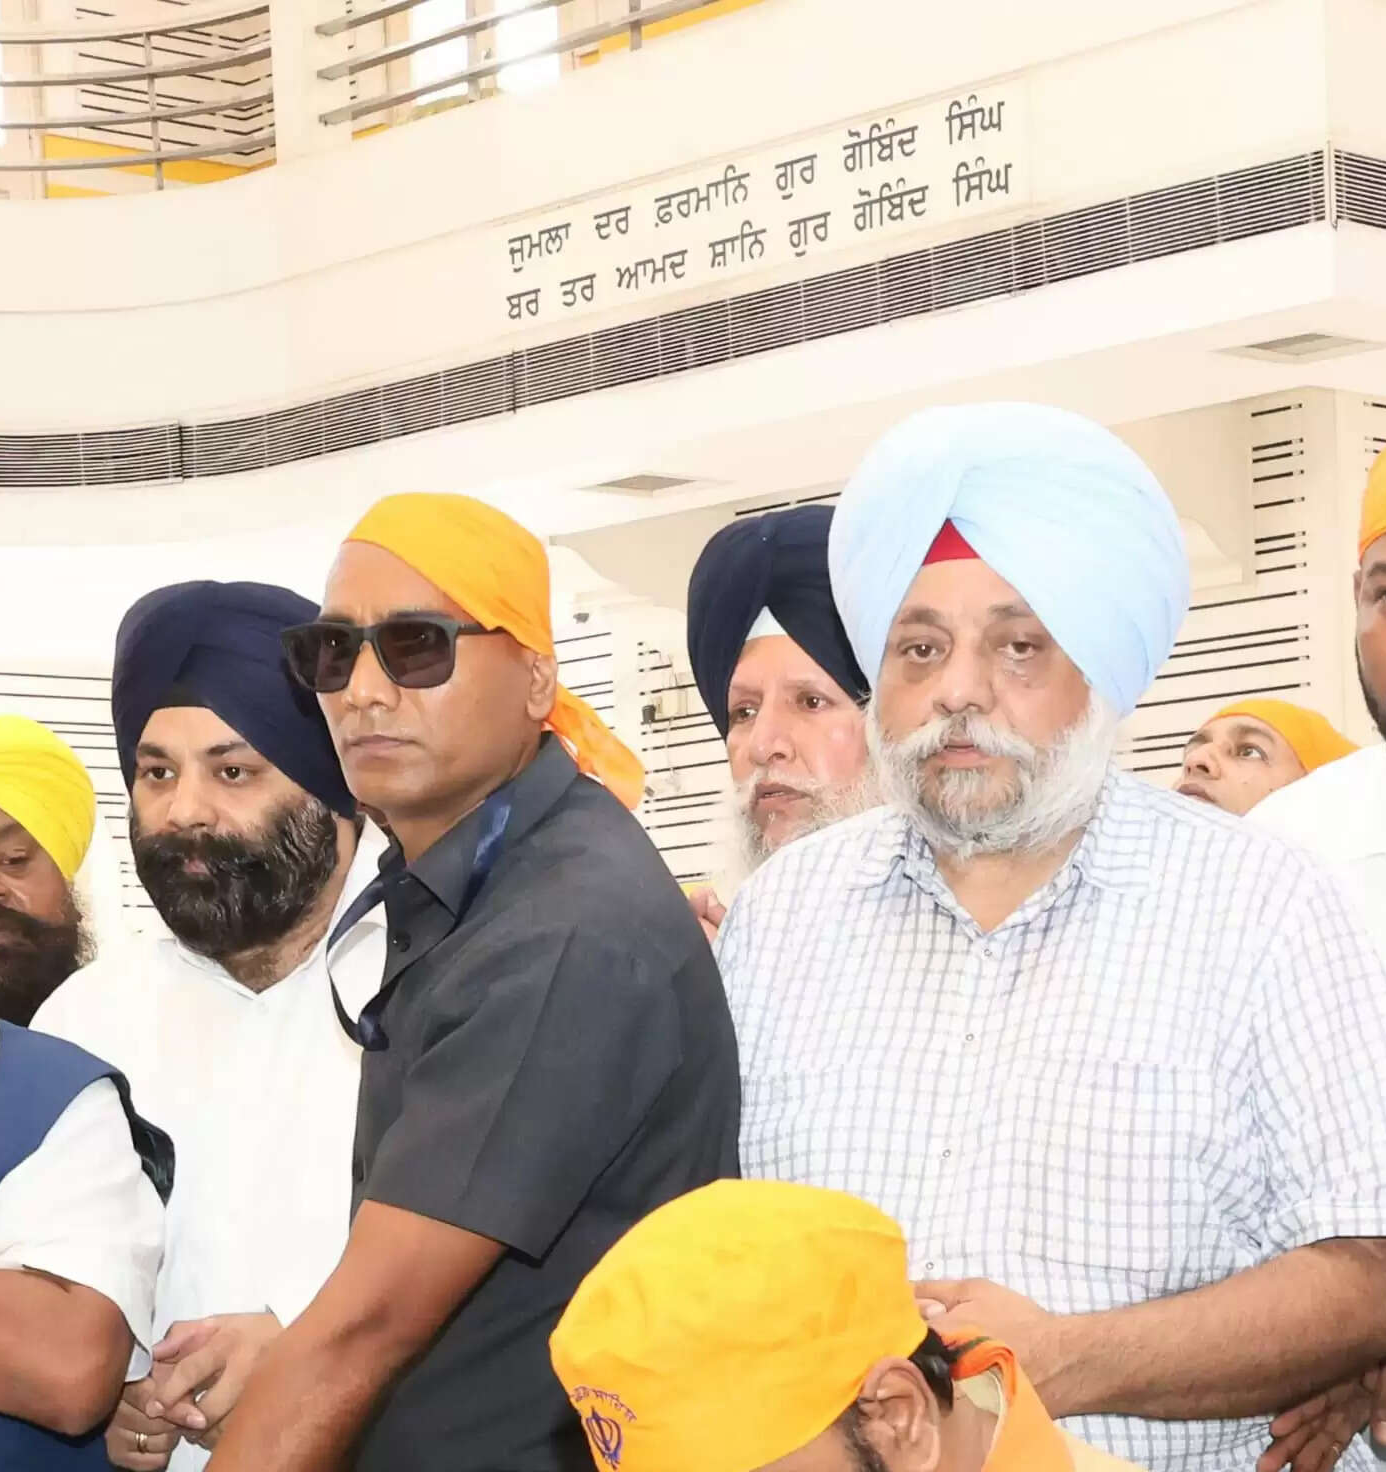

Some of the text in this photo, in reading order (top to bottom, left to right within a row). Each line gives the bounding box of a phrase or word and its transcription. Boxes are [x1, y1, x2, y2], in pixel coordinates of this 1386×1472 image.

[506, 156, 1013, 320] ਬਰ ਤਰ ਆਮਦ ਸ਼ਾਨਿ ਗੁਰ ਗੋਬਿੰਦ ਸਿੰਘ
[507, 222, 572, 273] ਜੁਮਲਾ
[593, 205, 632, 241] ਦਰ
[774, 153, 818, 201] ਗੁਰ
[842, 117, 919, 173] ਗੋਬਿੰਦ
[944, 94, 1005, 145] ਸਿੰਘ
